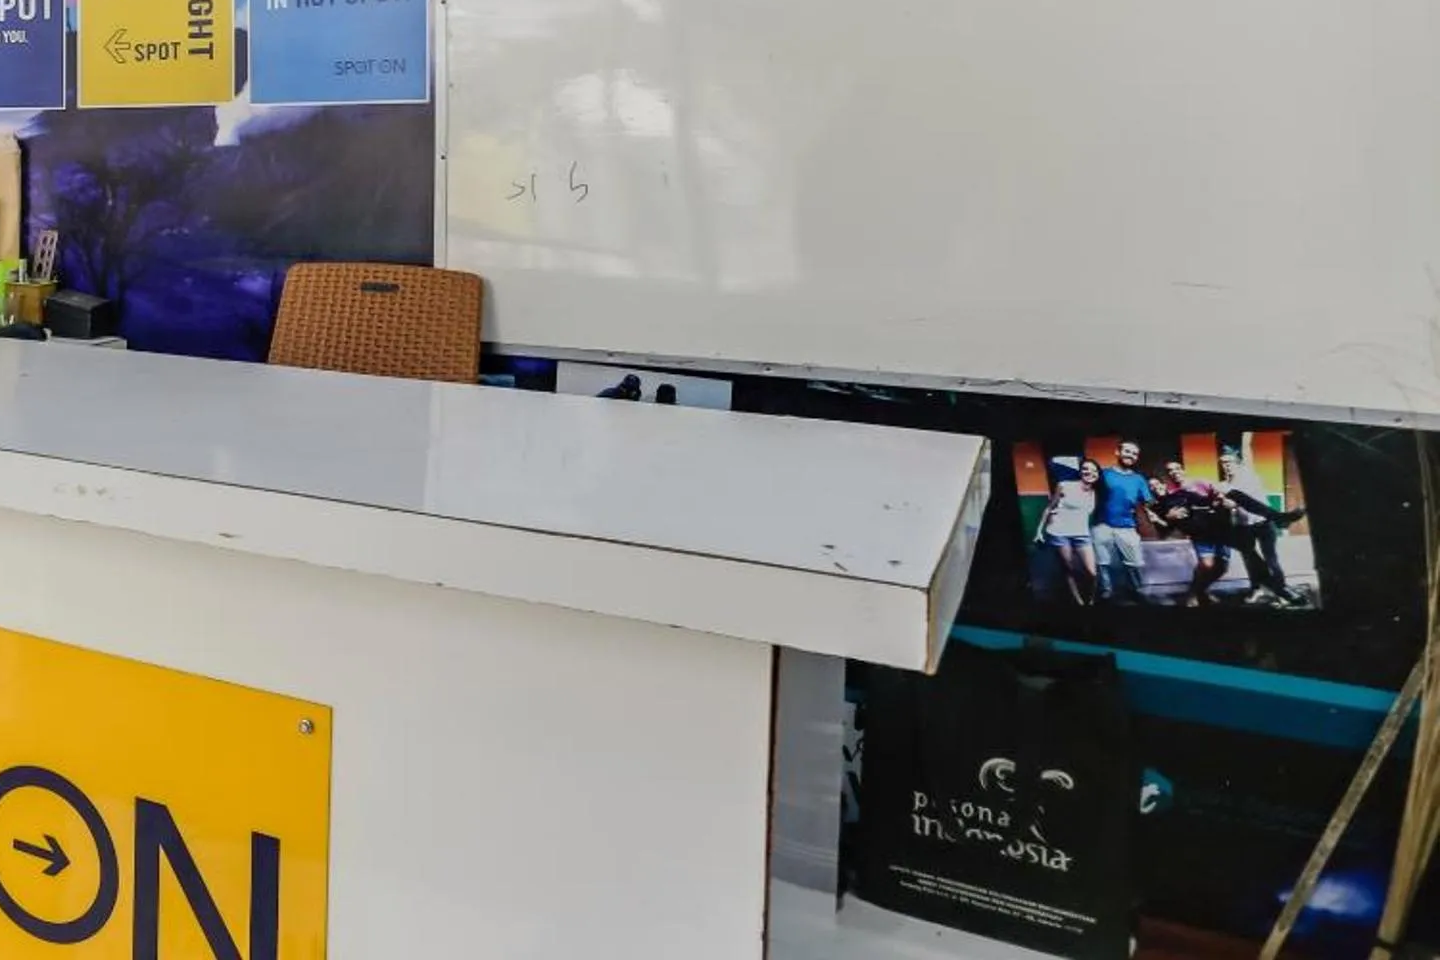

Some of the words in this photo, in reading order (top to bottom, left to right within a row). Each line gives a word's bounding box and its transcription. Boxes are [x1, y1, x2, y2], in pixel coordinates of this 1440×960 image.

[134, 42, 181, 62] SPOT
[333, 59, 376, 76] SPOT
[378, 57, 406, 74] ON
